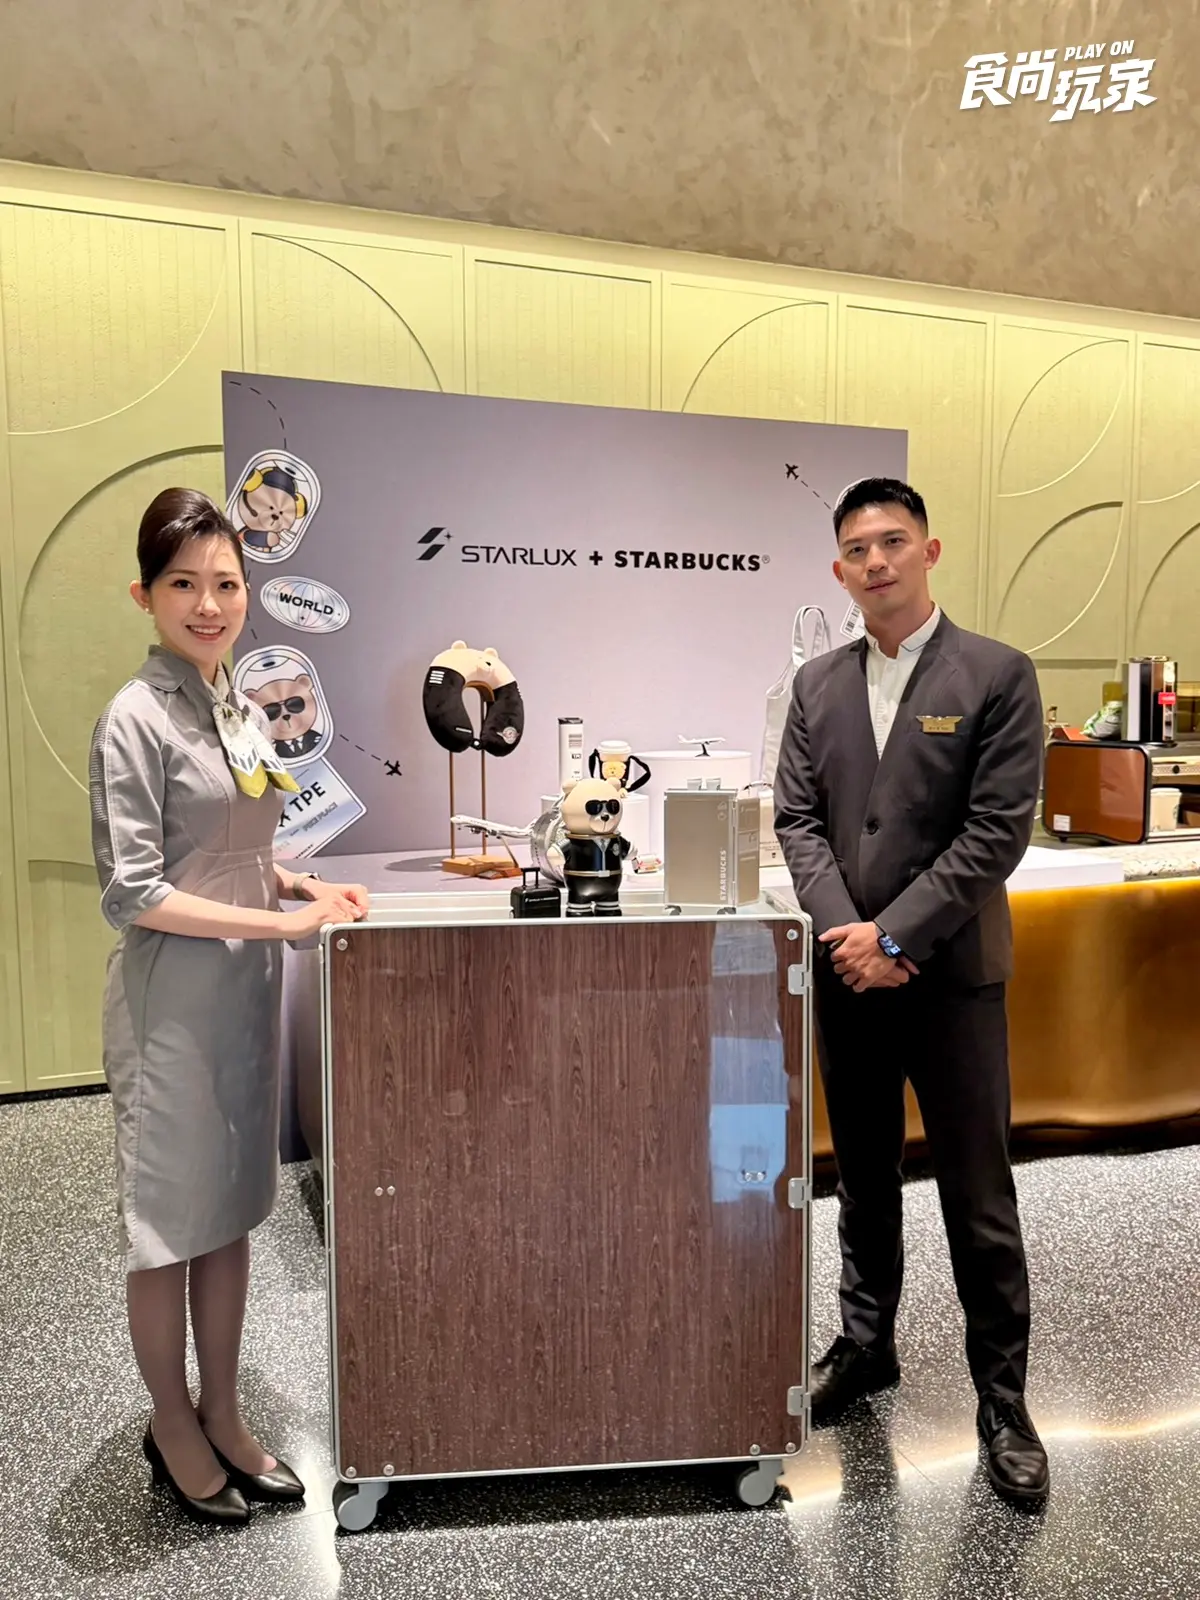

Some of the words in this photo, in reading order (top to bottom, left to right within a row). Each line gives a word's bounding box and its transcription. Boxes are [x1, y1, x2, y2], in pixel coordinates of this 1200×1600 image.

[461, 545, 577, 566] STARLUX
[280, 593, 333, 615] WORLD
[289, 782, 326, 812] TPE
